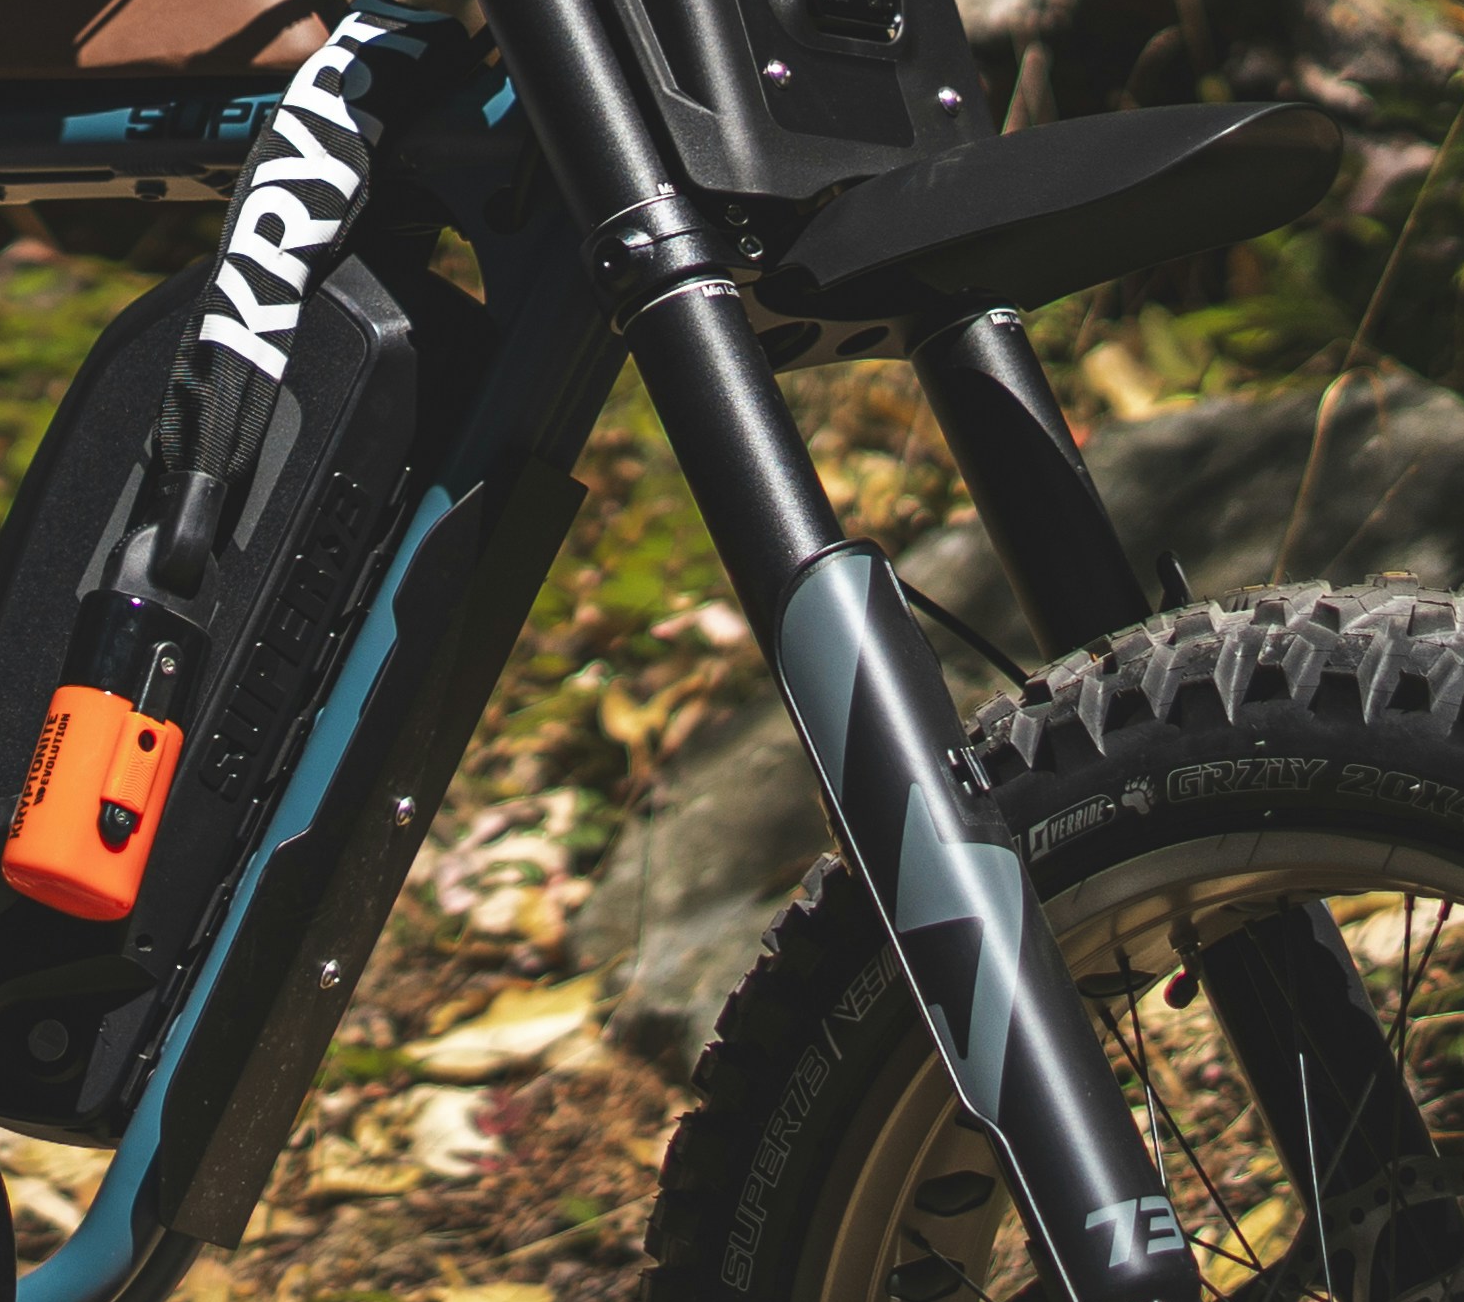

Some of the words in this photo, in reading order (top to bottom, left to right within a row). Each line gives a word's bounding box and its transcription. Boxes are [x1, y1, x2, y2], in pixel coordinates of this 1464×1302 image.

[198, 471, 370, 804] SUPER73
[10, 711, 59, 840] KRYPTONITE
[40, 713, 71, 786] EVOLUTION
[1166, 758, 1328, 803] GRZLY
[722, 1051, 828, 1292] SUPER73
[1084, 1195, 1186, 1269] 73
